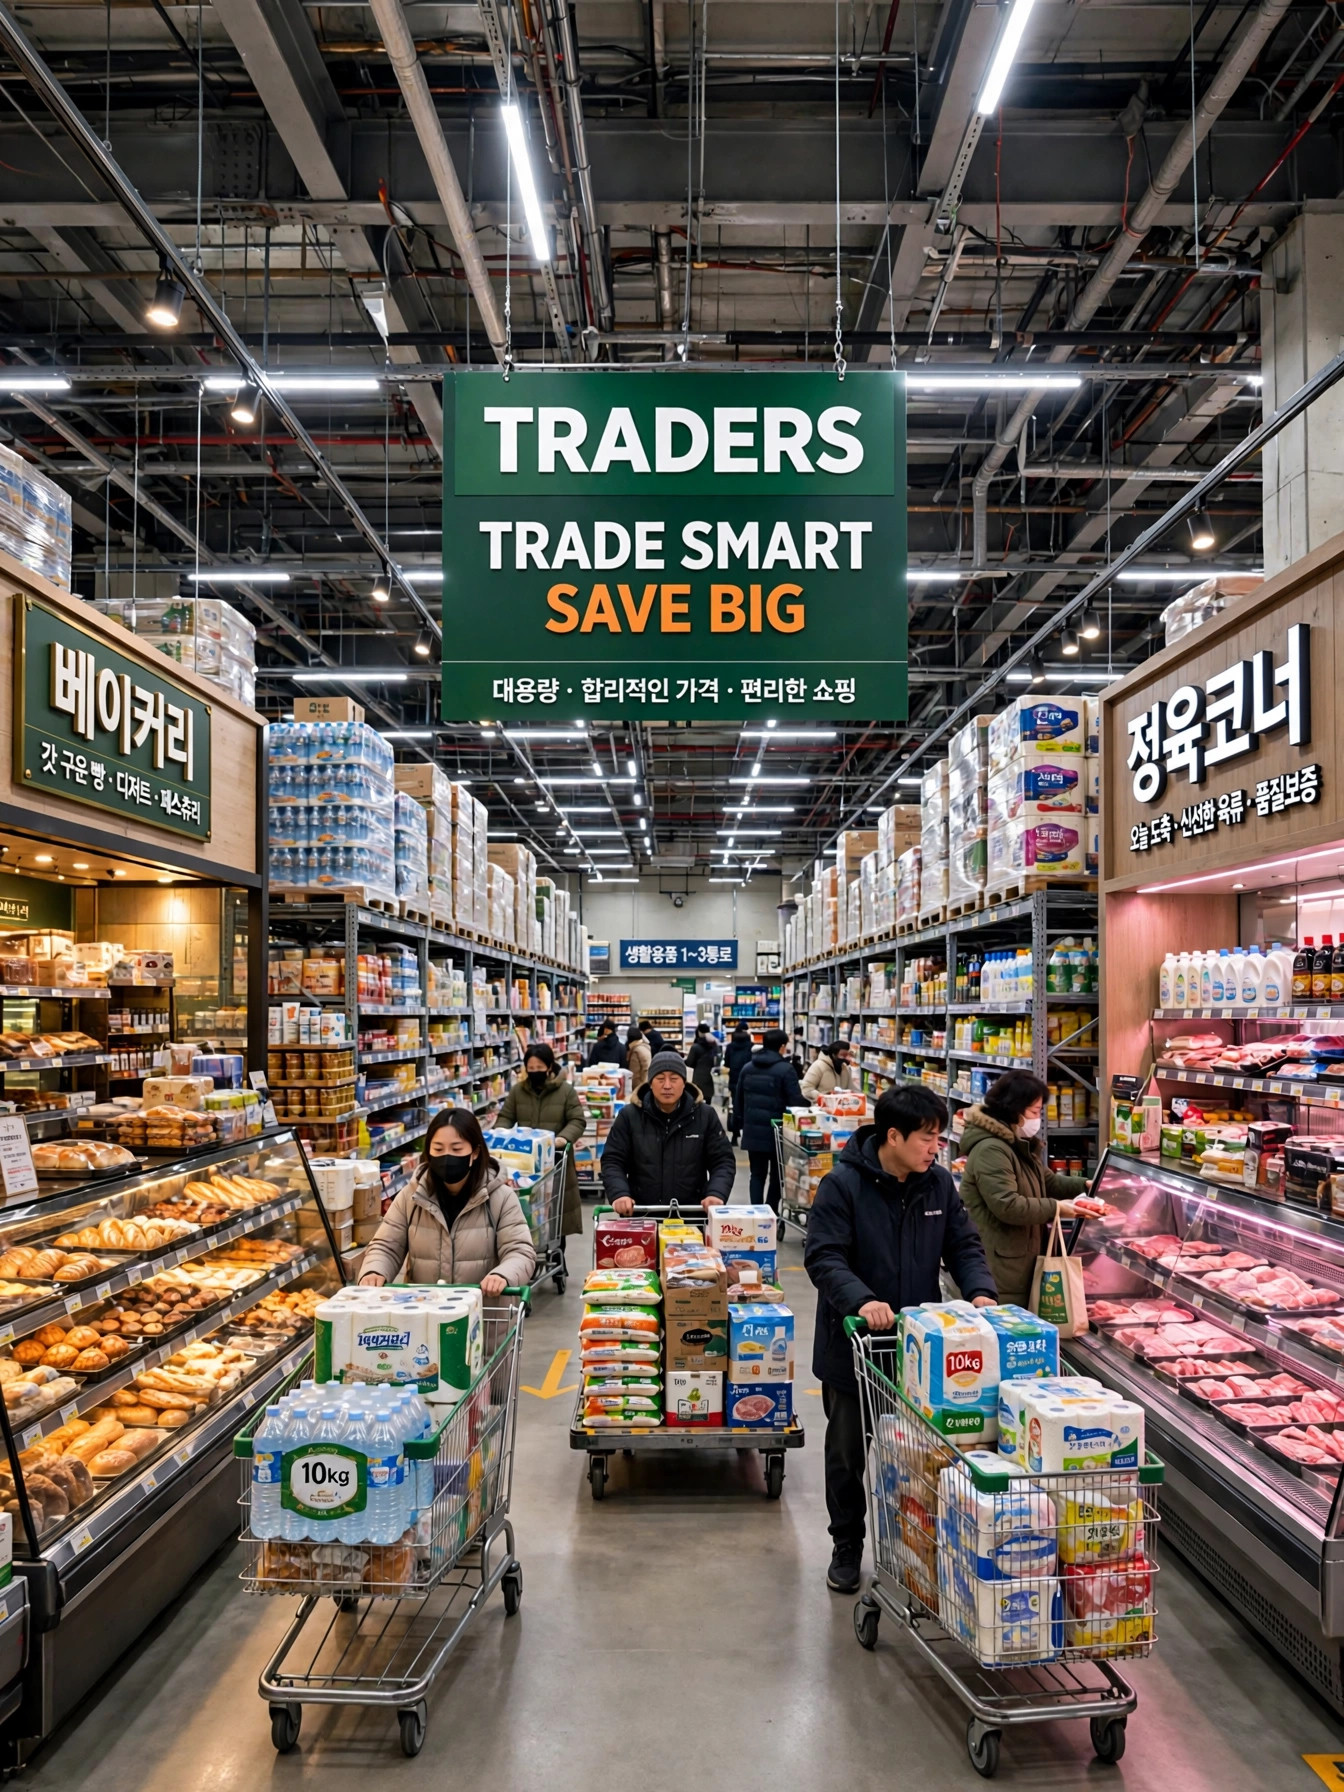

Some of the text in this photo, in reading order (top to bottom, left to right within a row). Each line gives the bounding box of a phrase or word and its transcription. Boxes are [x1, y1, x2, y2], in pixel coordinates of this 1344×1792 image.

[484, 405, 865, 474] TRADERS
[479, 520, 873, 571] TRADE SMART
[545, 583, 805, 633] SAVE BIG
[51, 641, 194, 782] 베이커리
[492, 677, 856, 704] 대용량 합리적인 가격 편리한 쇼핑
[1127, 623, 1311, 803] 정육코너
[41, 741, 58, 775] 갓
[60, 749, 89, 785] 구운
[90, 760, 106, 791] 빵
[116, 771, 152, 806] 디저트
[1129, 764, 1319, 851] 오늘 도축 신선한 육류 품질보증
[625, 945, 733, 964] 생활용품 1~3통로
[302, 1462, 350, 1487] 10kg
